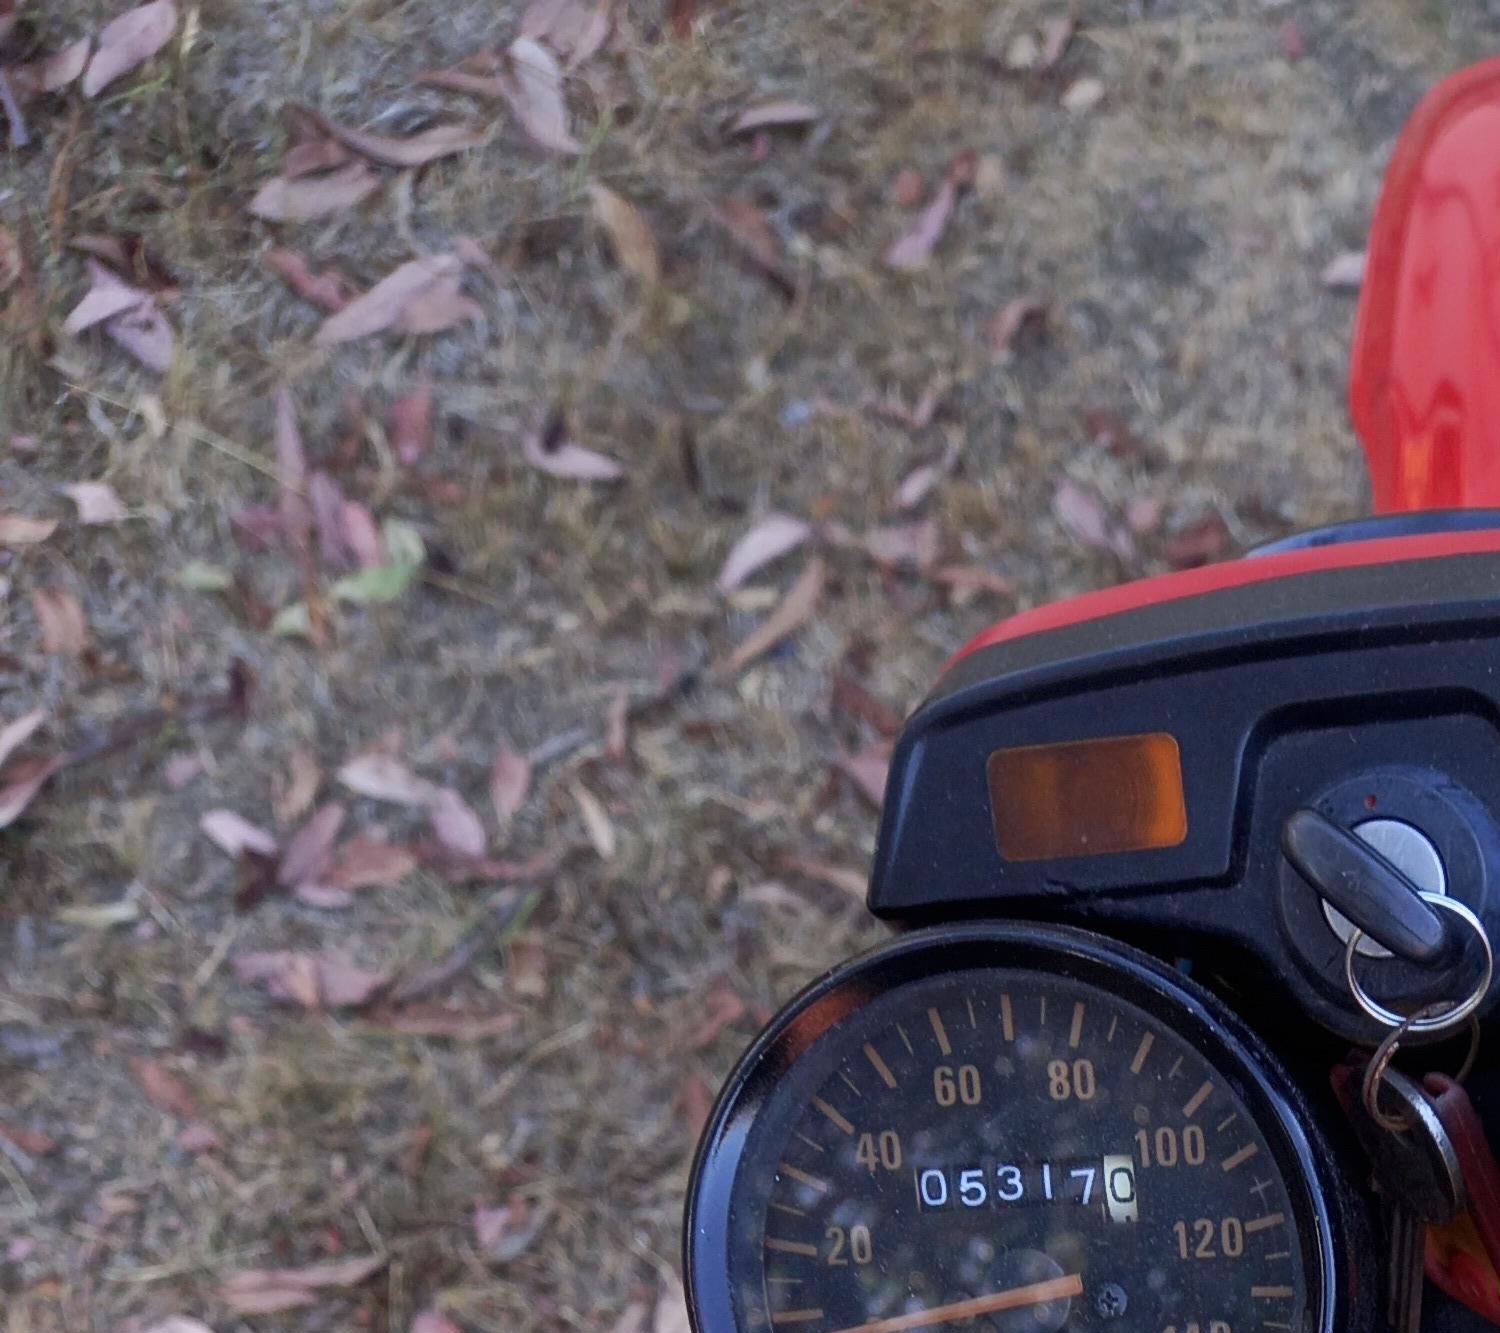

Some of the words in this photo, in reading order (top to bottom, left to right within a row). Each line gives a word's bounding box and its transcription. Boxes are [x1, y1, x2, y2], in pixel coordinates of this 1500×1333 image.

[933, 1064, 983, 1107] 60
[1046, 1059, 1097, 1101] 80
[854, 1129, 902, 1172] 40
[1135, 1126, 1207, 1169] 100
[824, 1224, 873, 1267] 20
[1173, 1216, 1245, 1260] 120
